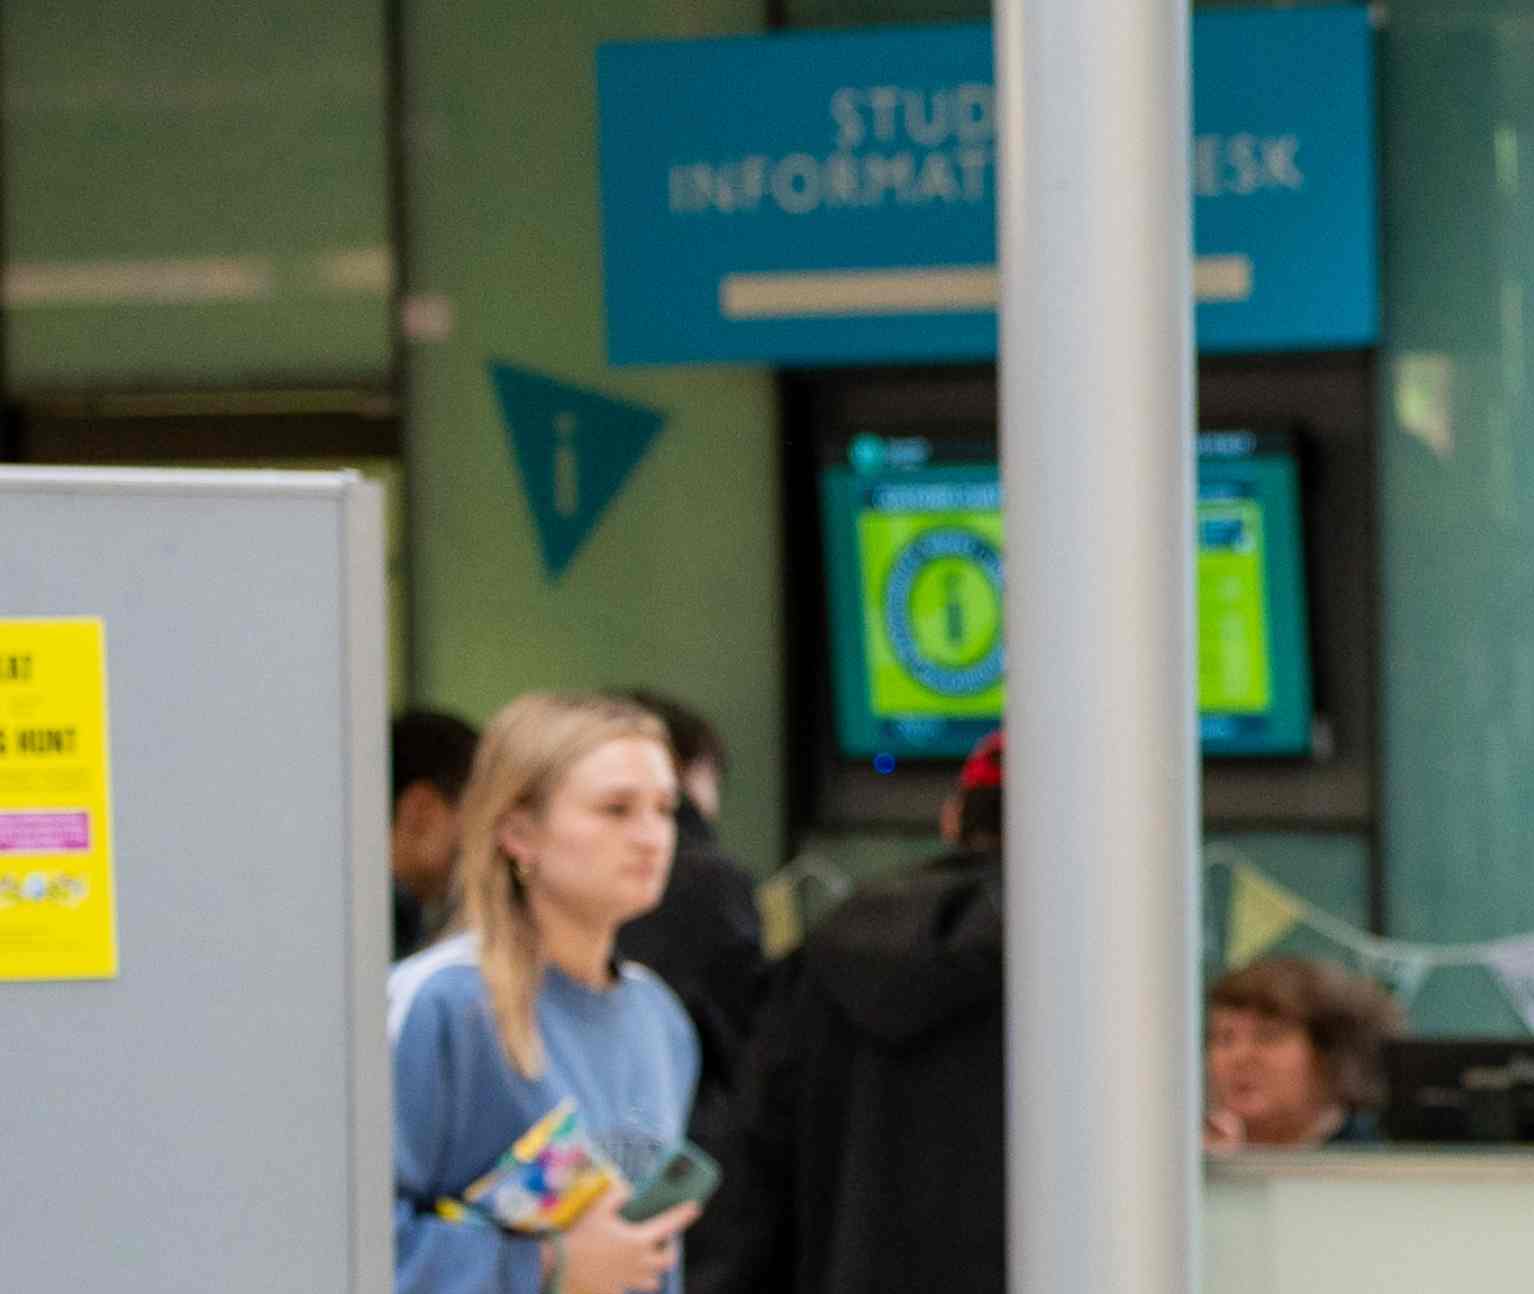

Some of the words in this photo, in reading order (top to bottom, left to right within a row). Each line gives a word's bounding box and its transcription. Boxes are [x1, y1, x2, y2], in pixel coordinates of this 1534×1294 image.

[829, 83, 997, 148] STUD
[668, 149, 997, 214] INFORMAT
[1194, 132, 1304, 197] ESK
